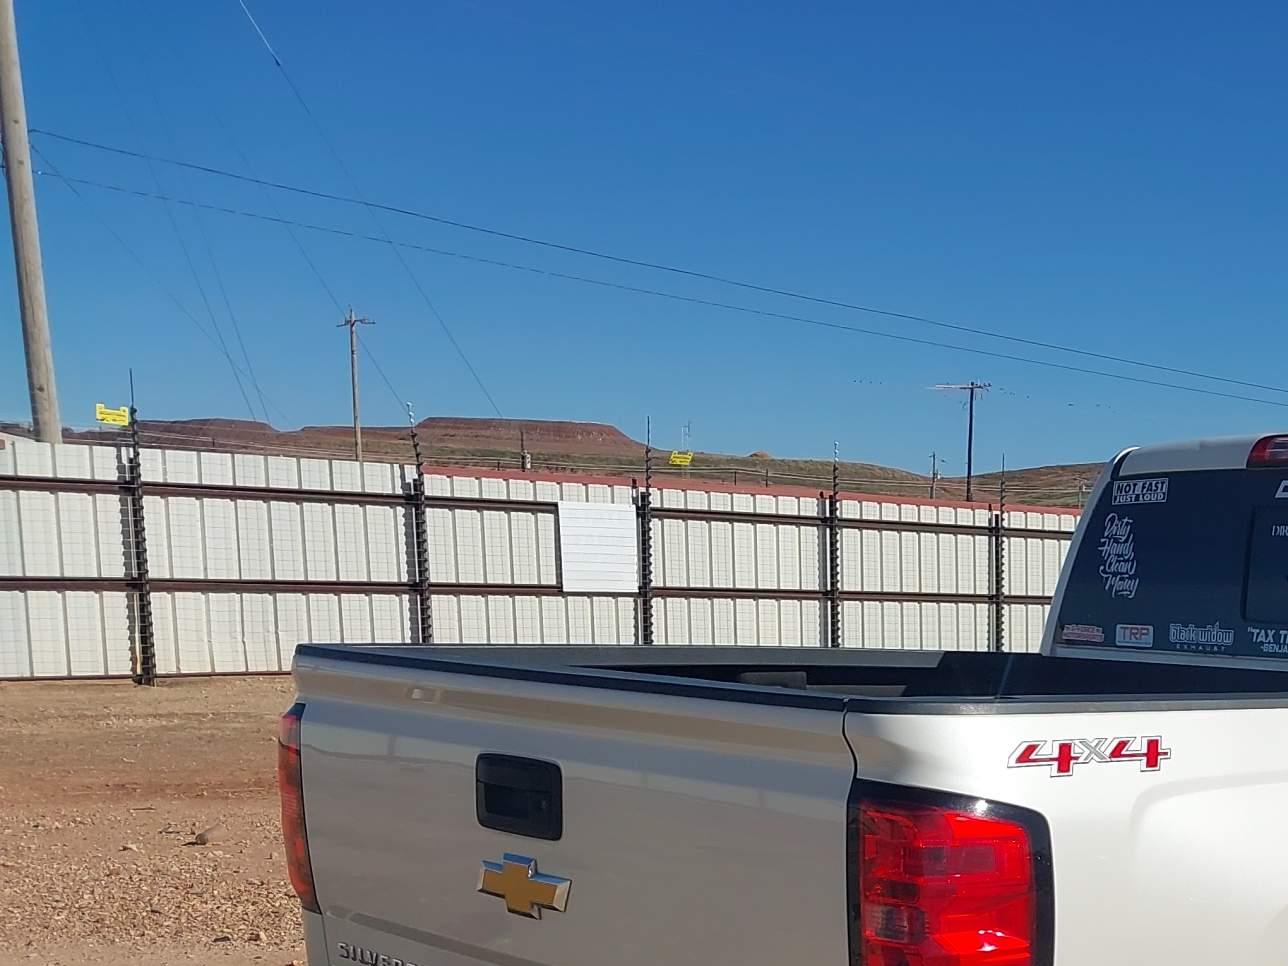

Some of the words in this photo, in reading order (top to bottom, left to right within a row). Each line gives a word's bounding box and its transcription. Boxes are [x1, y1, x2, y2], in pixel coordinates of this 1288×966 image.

[1115, 482, 1139, 495] NOT
[1141, 480, 1166, 494] FAST
[1114, 494, 1137, 503] JUST
[1140, 492, 1164, 502] LOUD
[1104, 512, 1134, 542] Dirty
